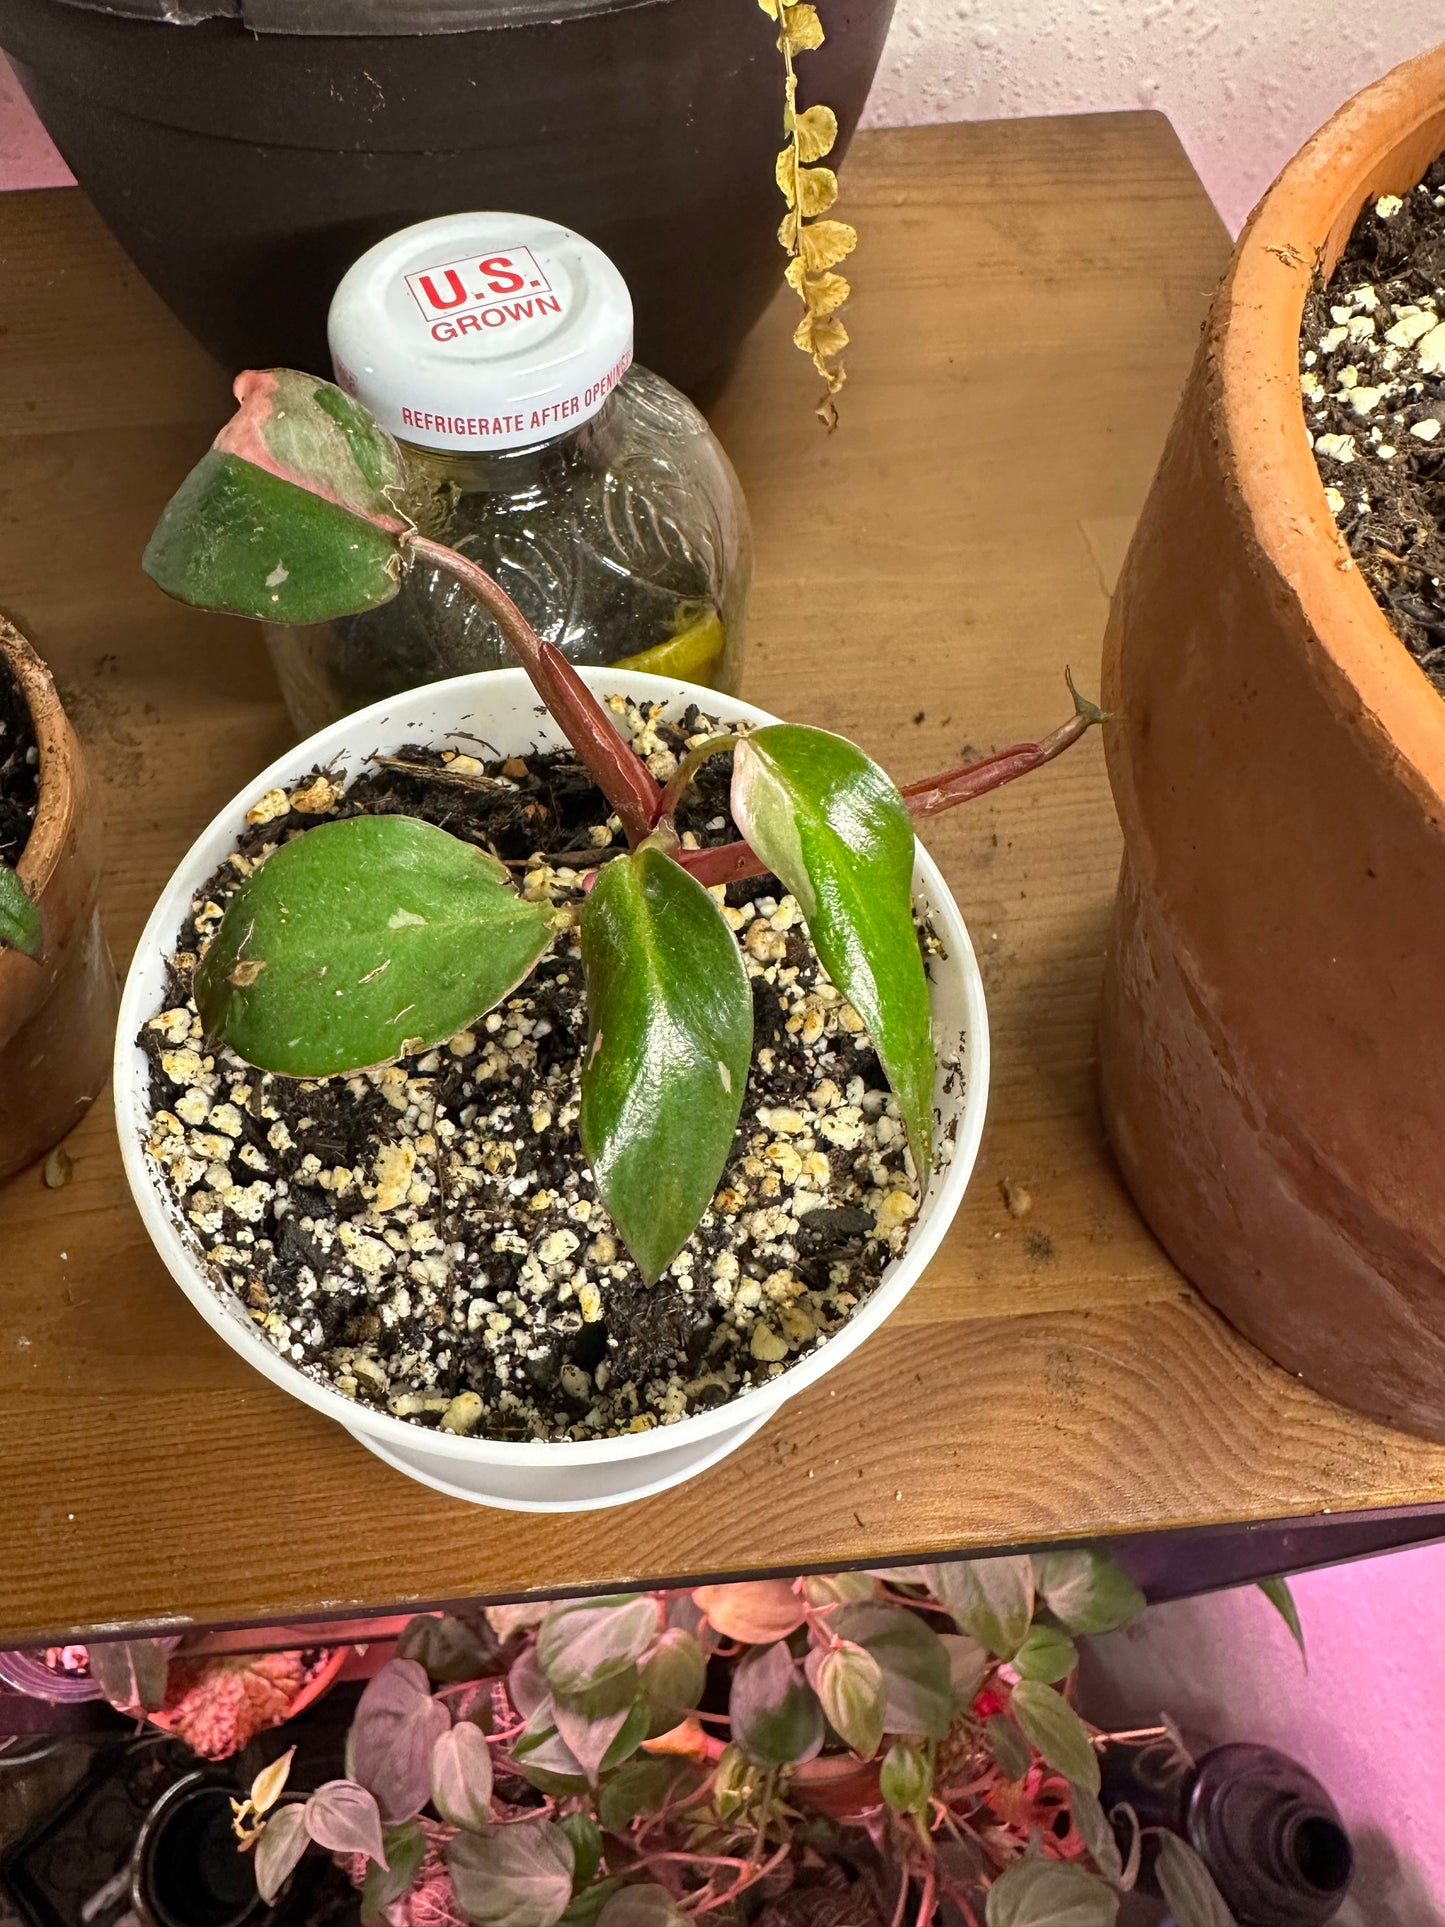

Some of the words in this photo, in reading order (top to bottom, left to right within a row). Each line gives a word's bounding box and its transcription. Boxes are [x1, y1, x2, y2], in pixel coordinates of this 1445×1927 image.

[419, 256, 541, 310] U.S.
[431, 295, 561, 342] GROWN
[402, 407, 523, 435] REFRIGERATE
[530, 396, 579, 429] AFTER
